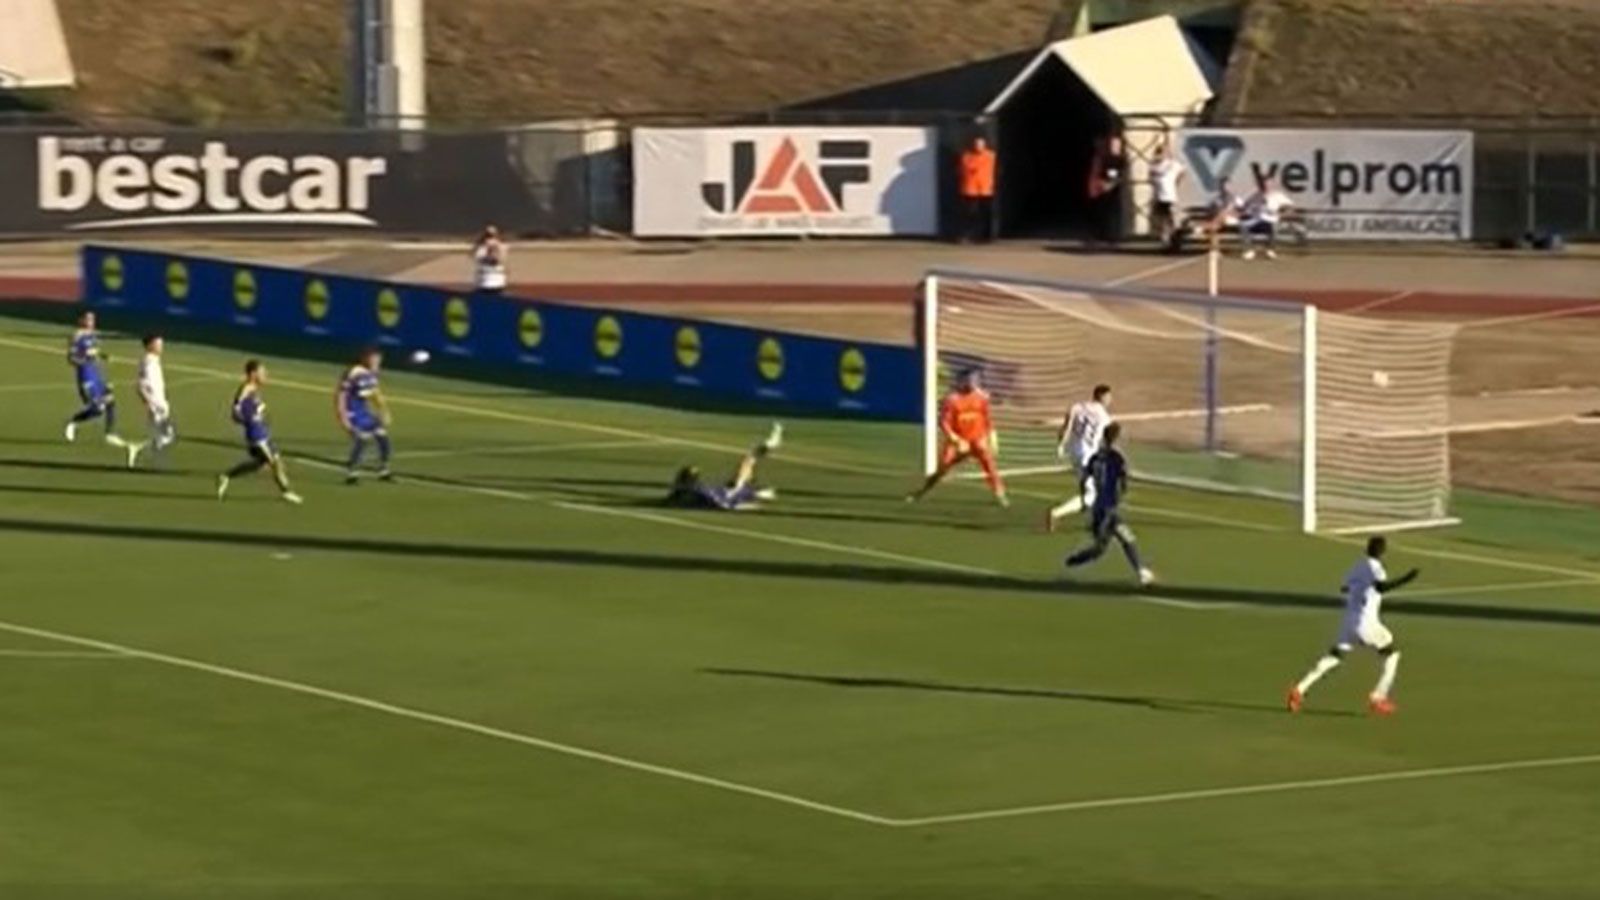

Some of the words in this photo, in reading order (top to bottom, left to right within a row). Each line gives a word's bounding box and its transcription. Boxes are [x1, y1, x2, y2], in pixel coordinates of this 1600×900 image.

[37, 135, 387, 211] bestcar
[129, 137, 167, 152] car
[700, 134, 872, 213] JAF
[1251, 149, 1463, 206] velprom
